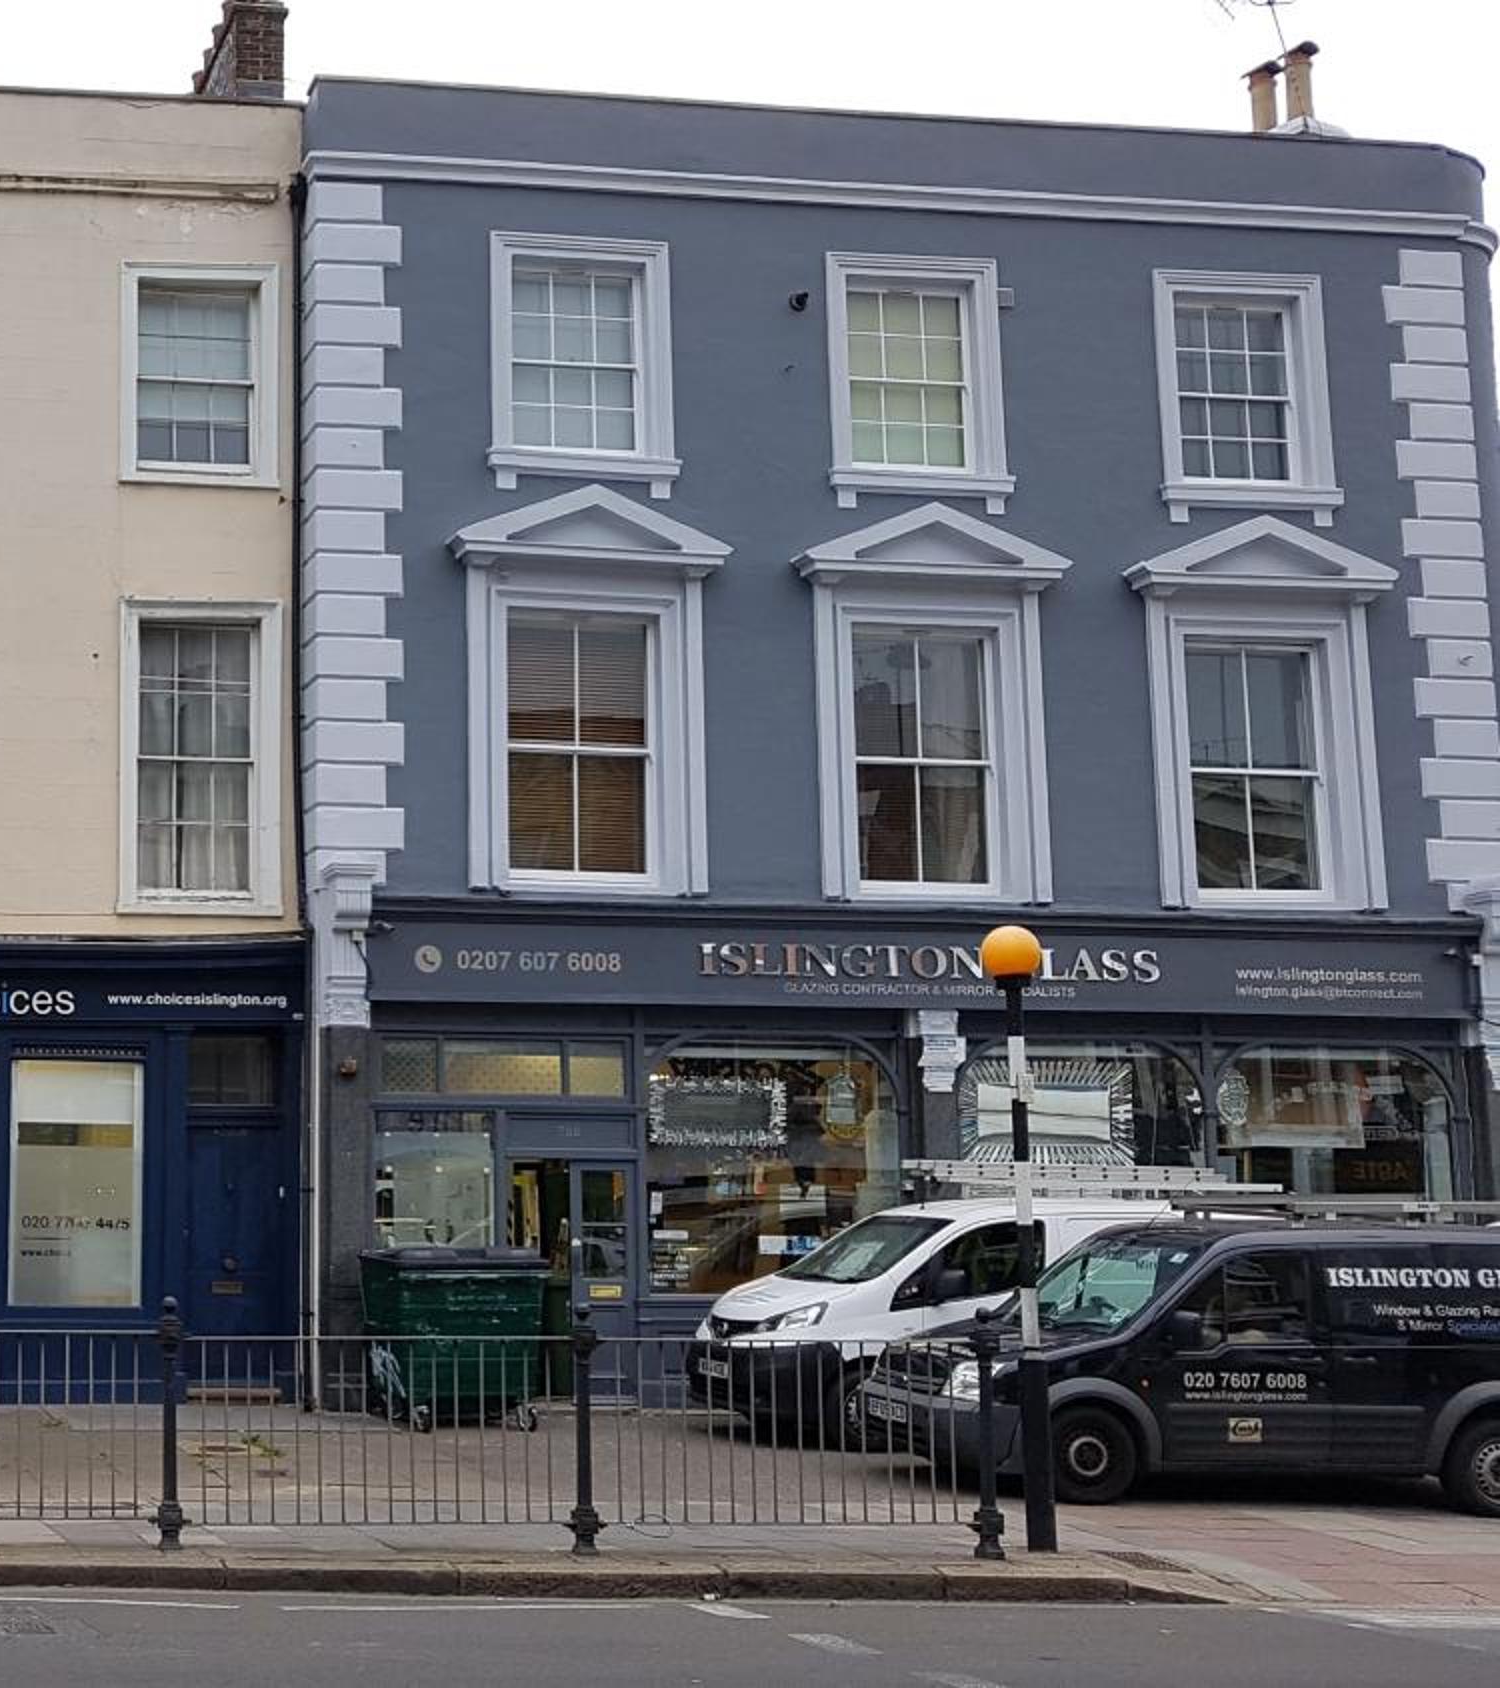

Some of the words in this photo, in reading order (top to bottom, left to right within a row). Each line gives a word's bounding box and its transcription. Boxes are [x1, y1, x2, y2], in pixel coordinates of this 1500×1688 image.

[457, 950, 512, 970] 0207
[519, 951, 560, 971] 607
[567, 952, 622, 972] 6008
[1040, 948, 1161, 983] LASS
[784, 982, 839, 995] GLAZING
[842, 984, 930, 996] CONTRACTOR
[998, 985, 1077, 998] SCIALISTS
[107, 991, 287, 1009] www.choicesislington.org
[21, 1215, 49, 1230] 020
[1326, 1267, 1470, 1288] ISLINGTON
[1373, 1303, 1421, 1316] Window
[1423, 1304, 1433, 1317] &
[1435, 1304, 1481, 1319] Glazing
[1409, 1319, 1444, 1331] Mirror
[1184, 1372, 1215, 1388] 020
[1220, 1372, 1261, 1389] 7607
[1266, 1372, 1307, 1390] 6008
